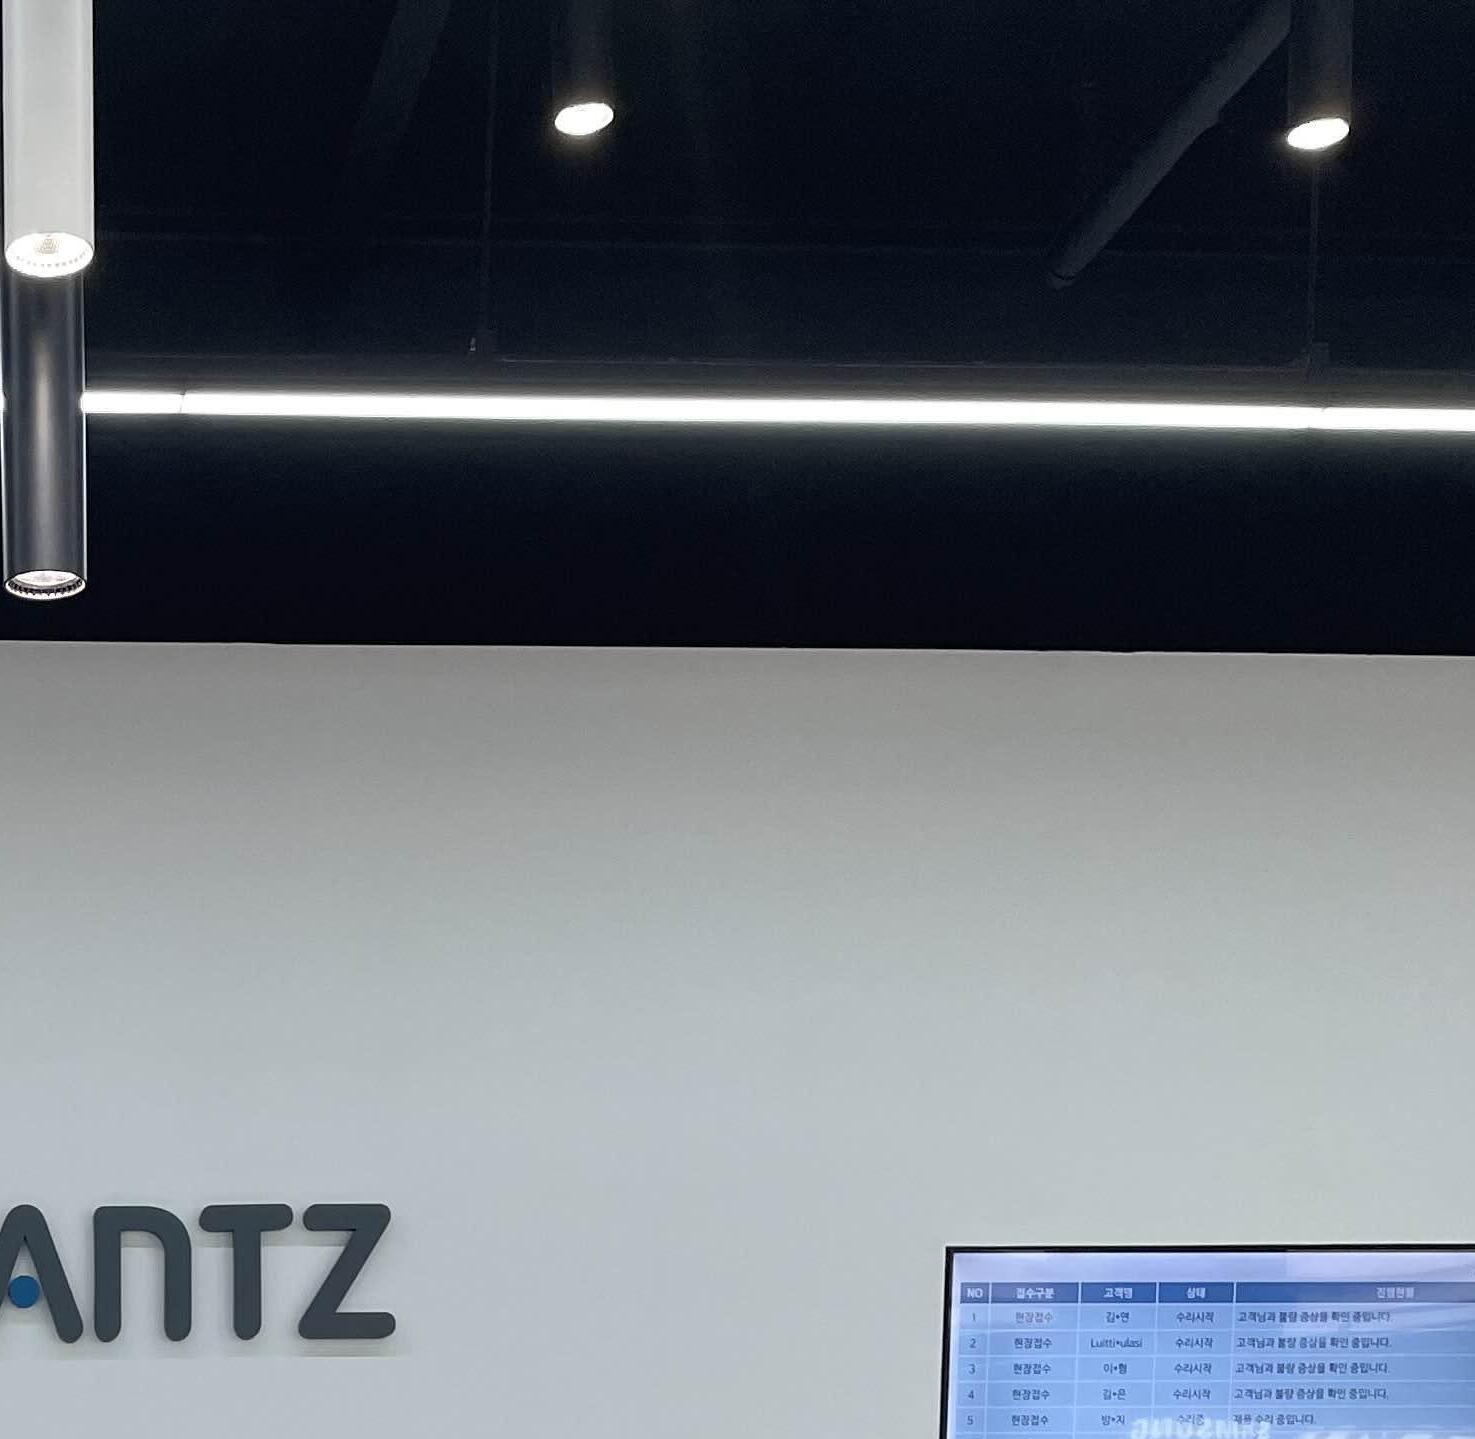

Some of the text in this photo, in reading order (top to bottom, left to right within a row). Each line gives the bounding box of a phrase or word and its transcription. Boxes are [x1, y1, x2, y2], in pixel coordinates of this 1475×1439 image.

[967, 1289, 983, 1298] NO
[1016, 1288, 1054, 1299] 접수구분
[1104, 1288, 1132, 1298] 고객명
[1187, 1288, 1206, 1298] 상태
[972, 1312, 976, 1321] 1
[1015, 1312, 1052, 1323] 현장접수
[1176, 1312, 1213, 1322] 수리시작
[1238, 1311, 1276, 1323] 고객님과
[1279, 1311, 1297, 1323] 불량
[1300, 1311, 1328, 1323] 증상을
[1331, 1311, 1349, 1323] 확인
[970, 1338, 976, 1348] 2
[1014, 1338, 1052, 1349] 현장접수
[1175, 1337, 1213, 1348] 수리시작
[1237, 1337, 1274, 1348] 고객님과
[1278, 1337, 1296, 1348] 불량
[1299, 1337, 1327, 1348] 증상을
[1330, 1337, 1348, 1348] 확인
[968, 1364, 975, 1374] 3
[1013, 1364, 1051, 1375] 현장접수
[1174, 1363, 1211, 1374] 수리시작
[1236, 1363, 1273, 1374] 고객님과
[1277, 1363, 1295, 1374] 불량
[1298, 1363, 1325, 1374] 증상을
[1329, 1363, 1348, 1374] 확인
[968, 1390, 974, 1399] 4
[1012, 1389, 1050, 1401] 현장접수
[1173, 1389, 1211, 1400] 수리시작
[1235, 1388, 1272, 1400] 고객님과
[1276, 1388, 1294, 1400] 불량
[1297, 1388, 1324, 1400] 증상을
[1328, 1388, 1346, 1400] 확인
[967, 1416, 973, 1426] 5
[1011, 1415, 1048, 1426] 현장접수
[1233, 1414, 1316, 1425] 제품 수리 중입니다.
